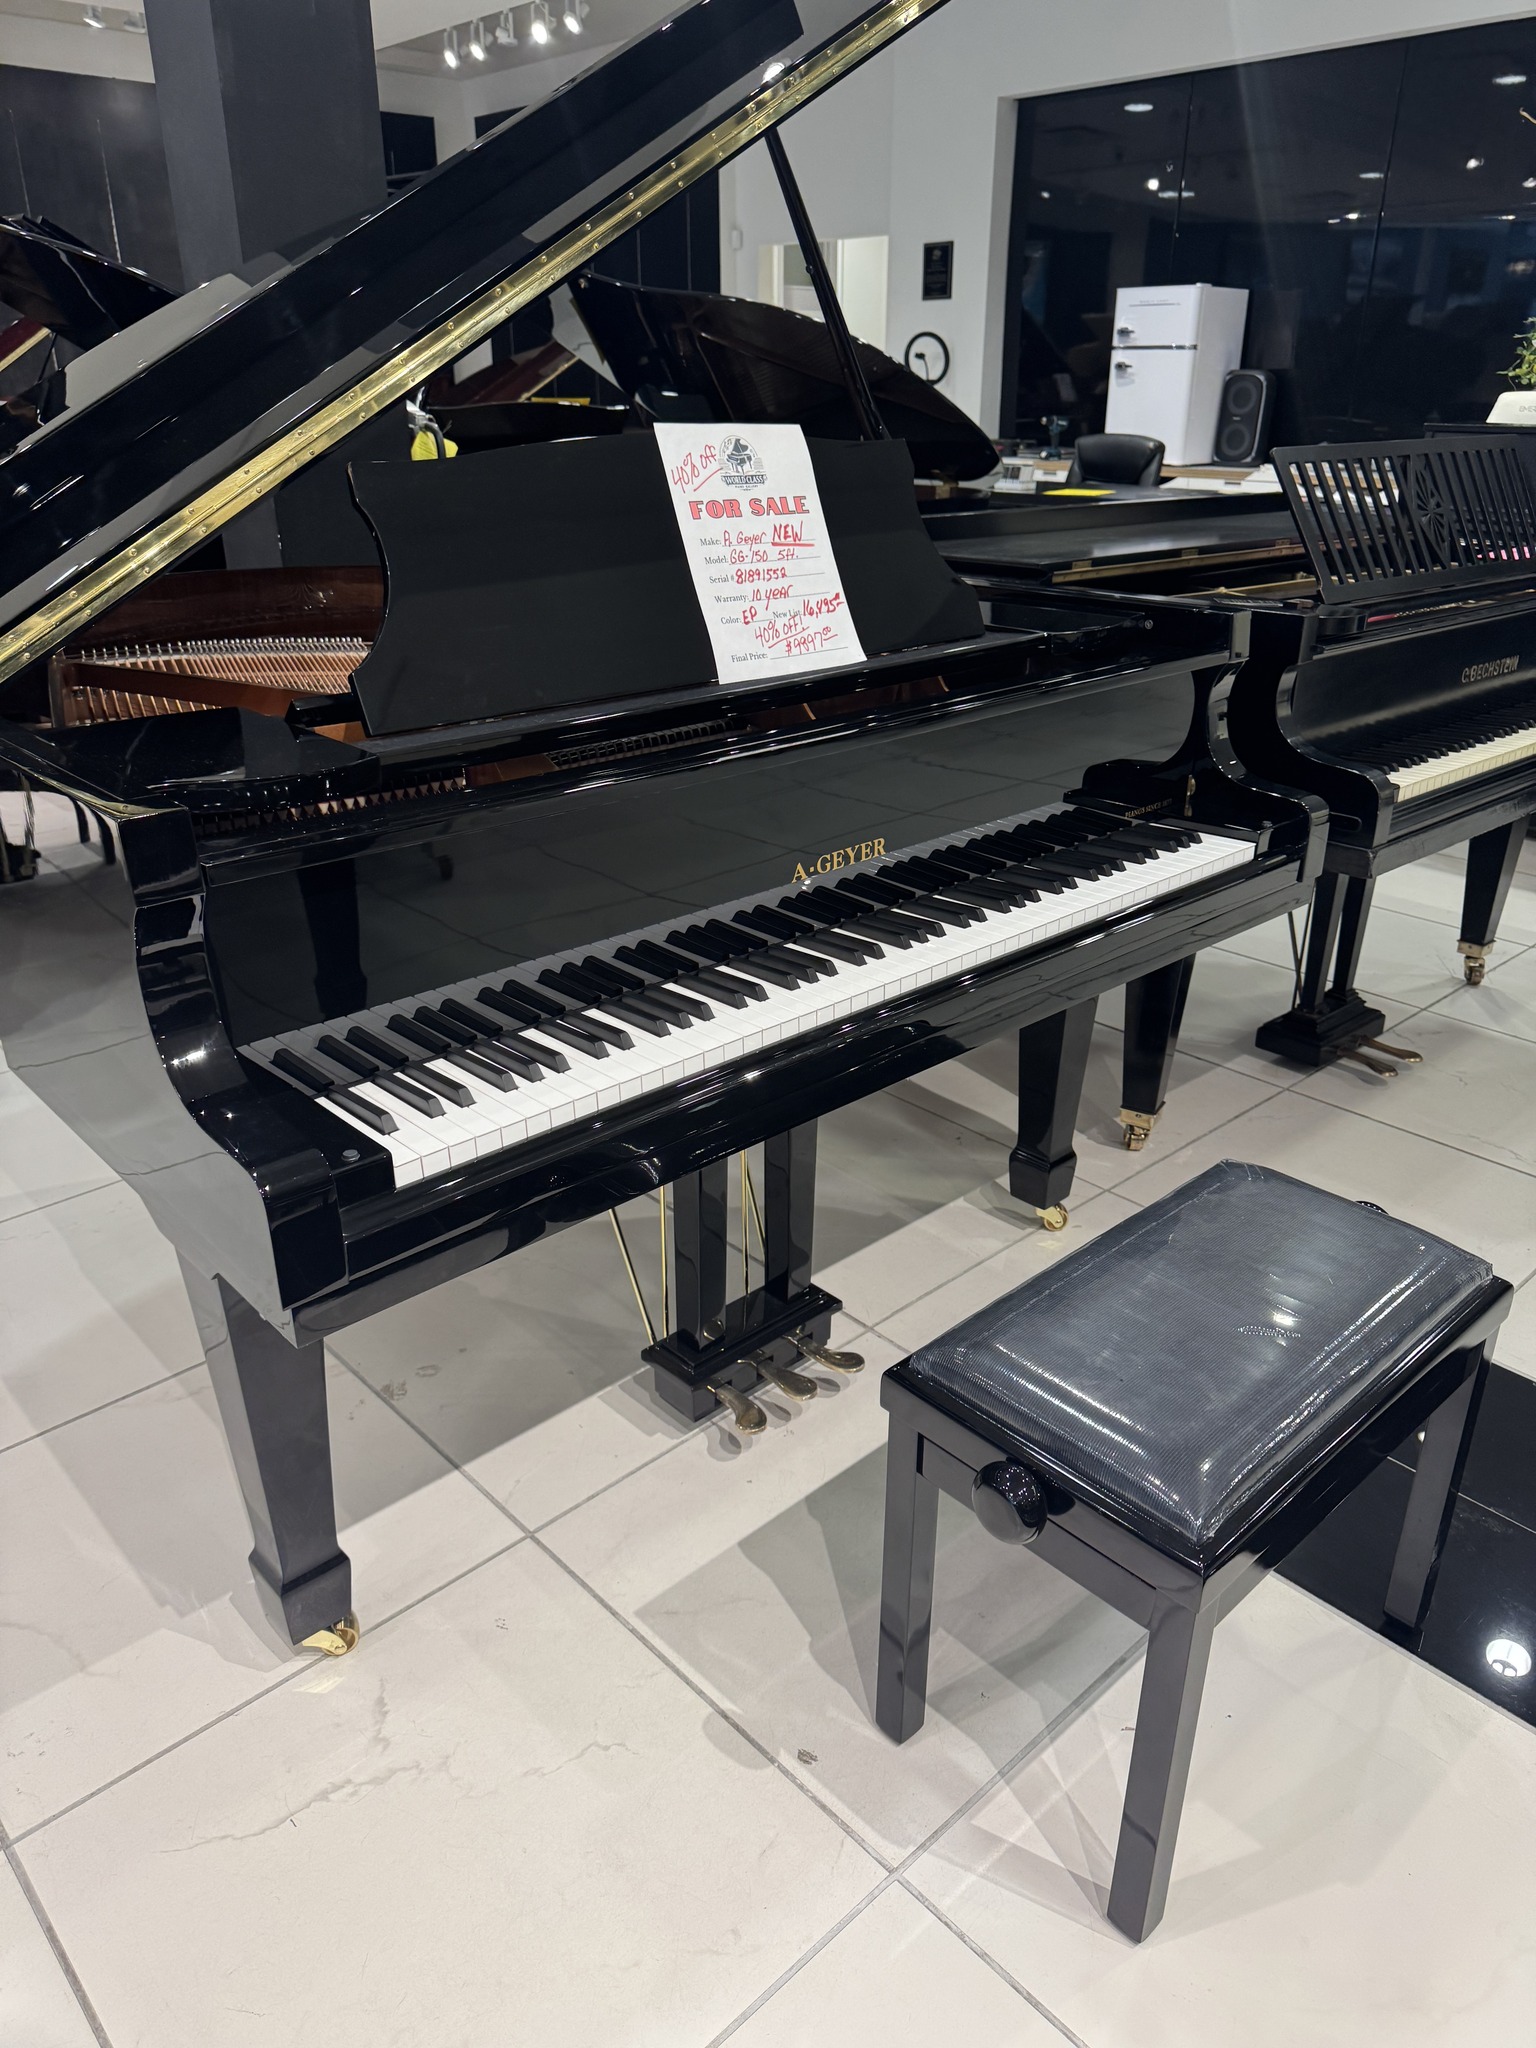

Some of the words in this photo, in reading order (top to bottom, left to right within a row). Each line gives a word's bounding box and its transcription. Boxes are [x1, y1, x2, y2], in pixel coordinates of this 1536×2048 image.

[671, 452, 700, 493] 40%
[725, 475, 746, 486] WORLD
[746, 475, 764, 484] CLASS
[689, 499, 743, 520] FOR
[749, 496, 810, 516] SALE
[737, 531, 767, 551] Geyer
[772, 520, 803, 543] NEW
[700, 538, 722, 546] Make:
[704, 556, 729, 565] Model:
[709, 575, 729, 584] Serial
[735, 567, 787, 584] 81891552
[714, 594, 749, 604] Warranty:
[752, 588, 761, 602] 10
[742, 605, 757, 625] EP
[772, 611, 788, 619] New
[720, 617, 741, 625] Color:
[754, 620, 780, 647] 40%
[731, 653, 748, 663] Final
[749, 652, 768, 660] Price:
